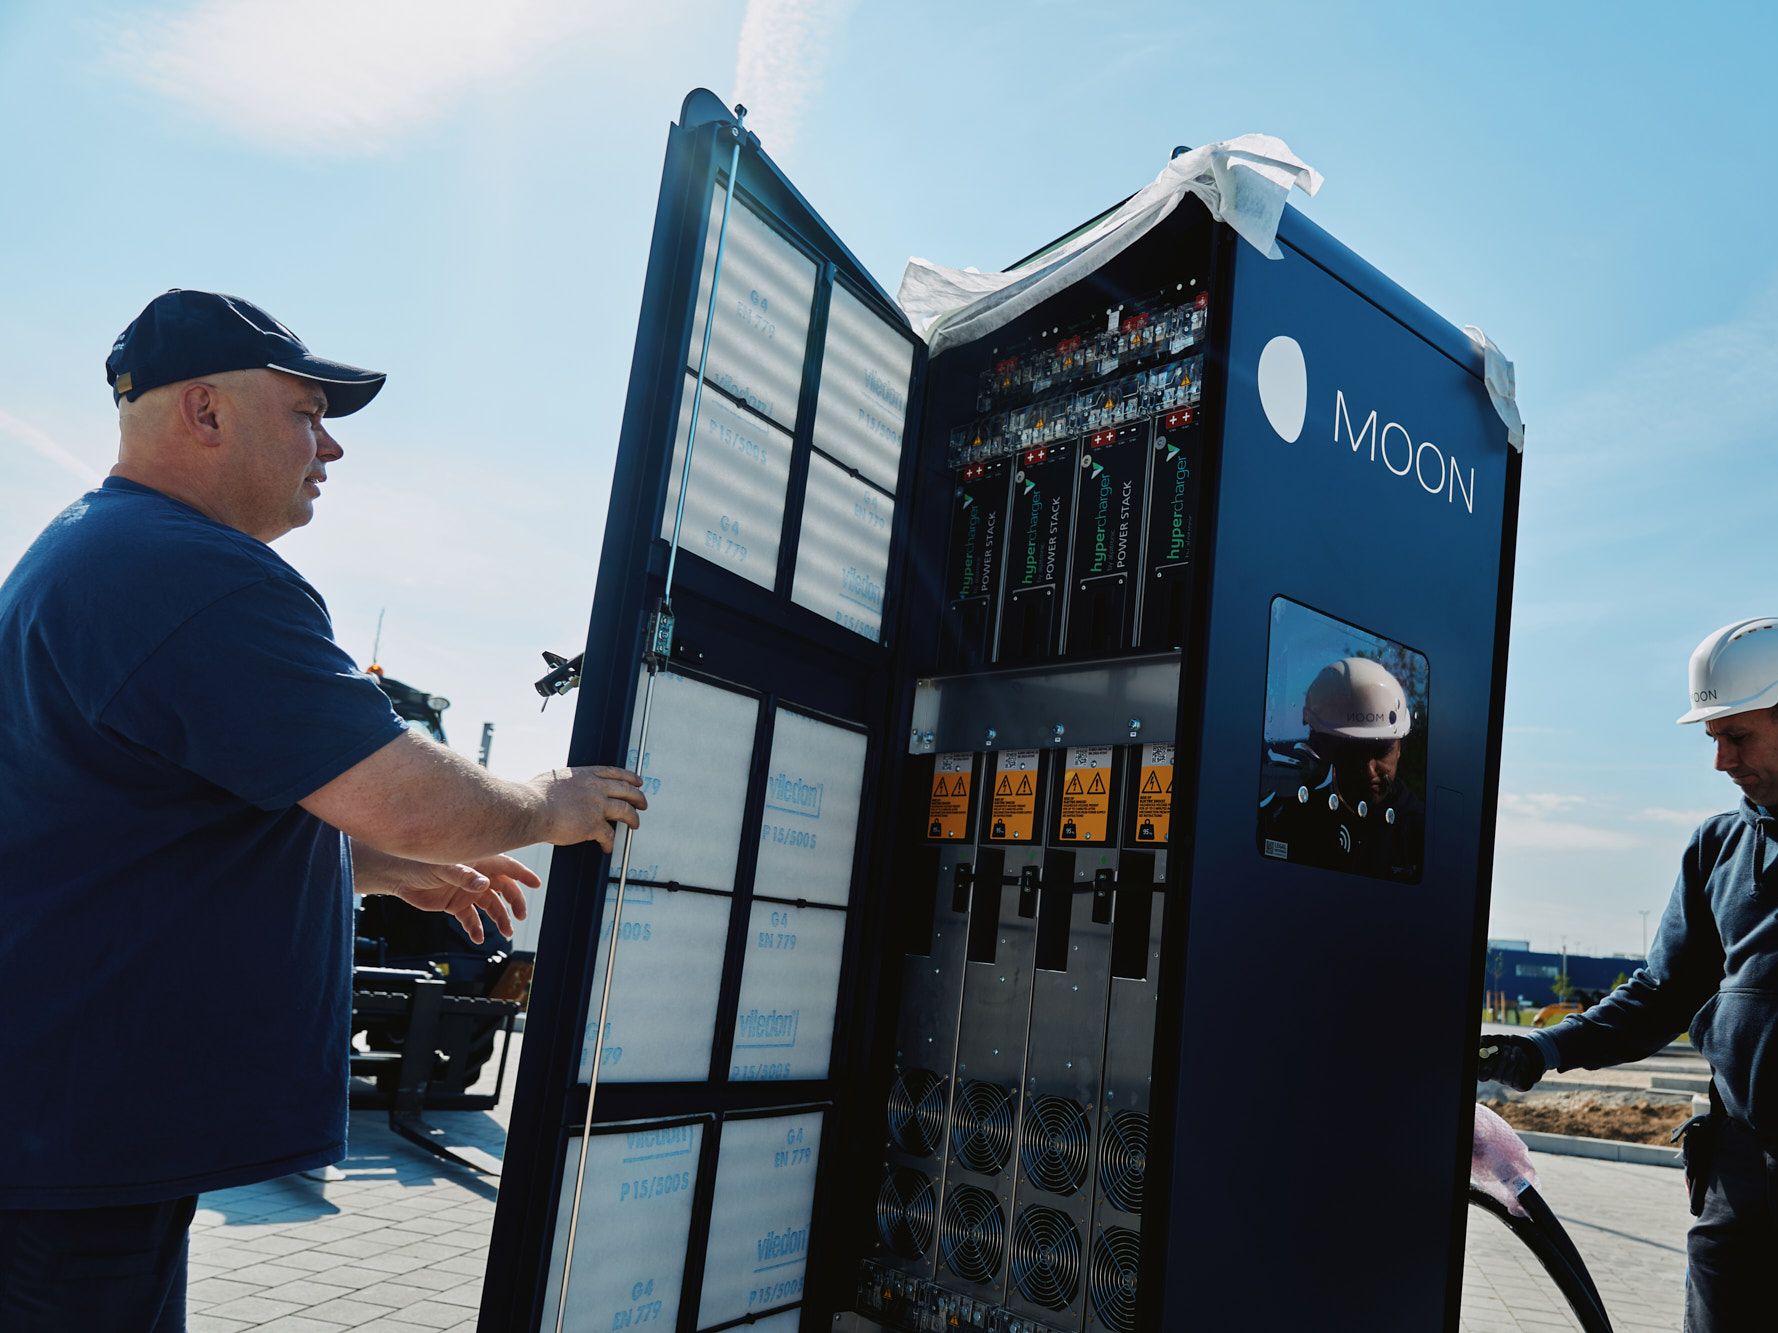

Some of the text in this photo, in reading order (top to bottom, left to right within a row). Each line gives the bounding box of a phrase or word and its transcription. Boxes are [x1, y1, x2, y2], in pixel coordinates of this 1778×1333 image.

[1334, 389, 1475, 514] MOON
[1022, 490, 1042, 584] hypercharger
[1046, 496, 1061, 580] POWER STACK
[1090, 474, 1113, 572] hypercharger
[1117, 480, 1132, 568] POWER STACK
[1166, 456, 1190, 559] hypercharger
[981, 511, 996, 591] POWER STACK
[1692, 690, 1718, 703] OON
[643, 776, 661, 795] 79
[602, 1047, 623, 1065] 79
